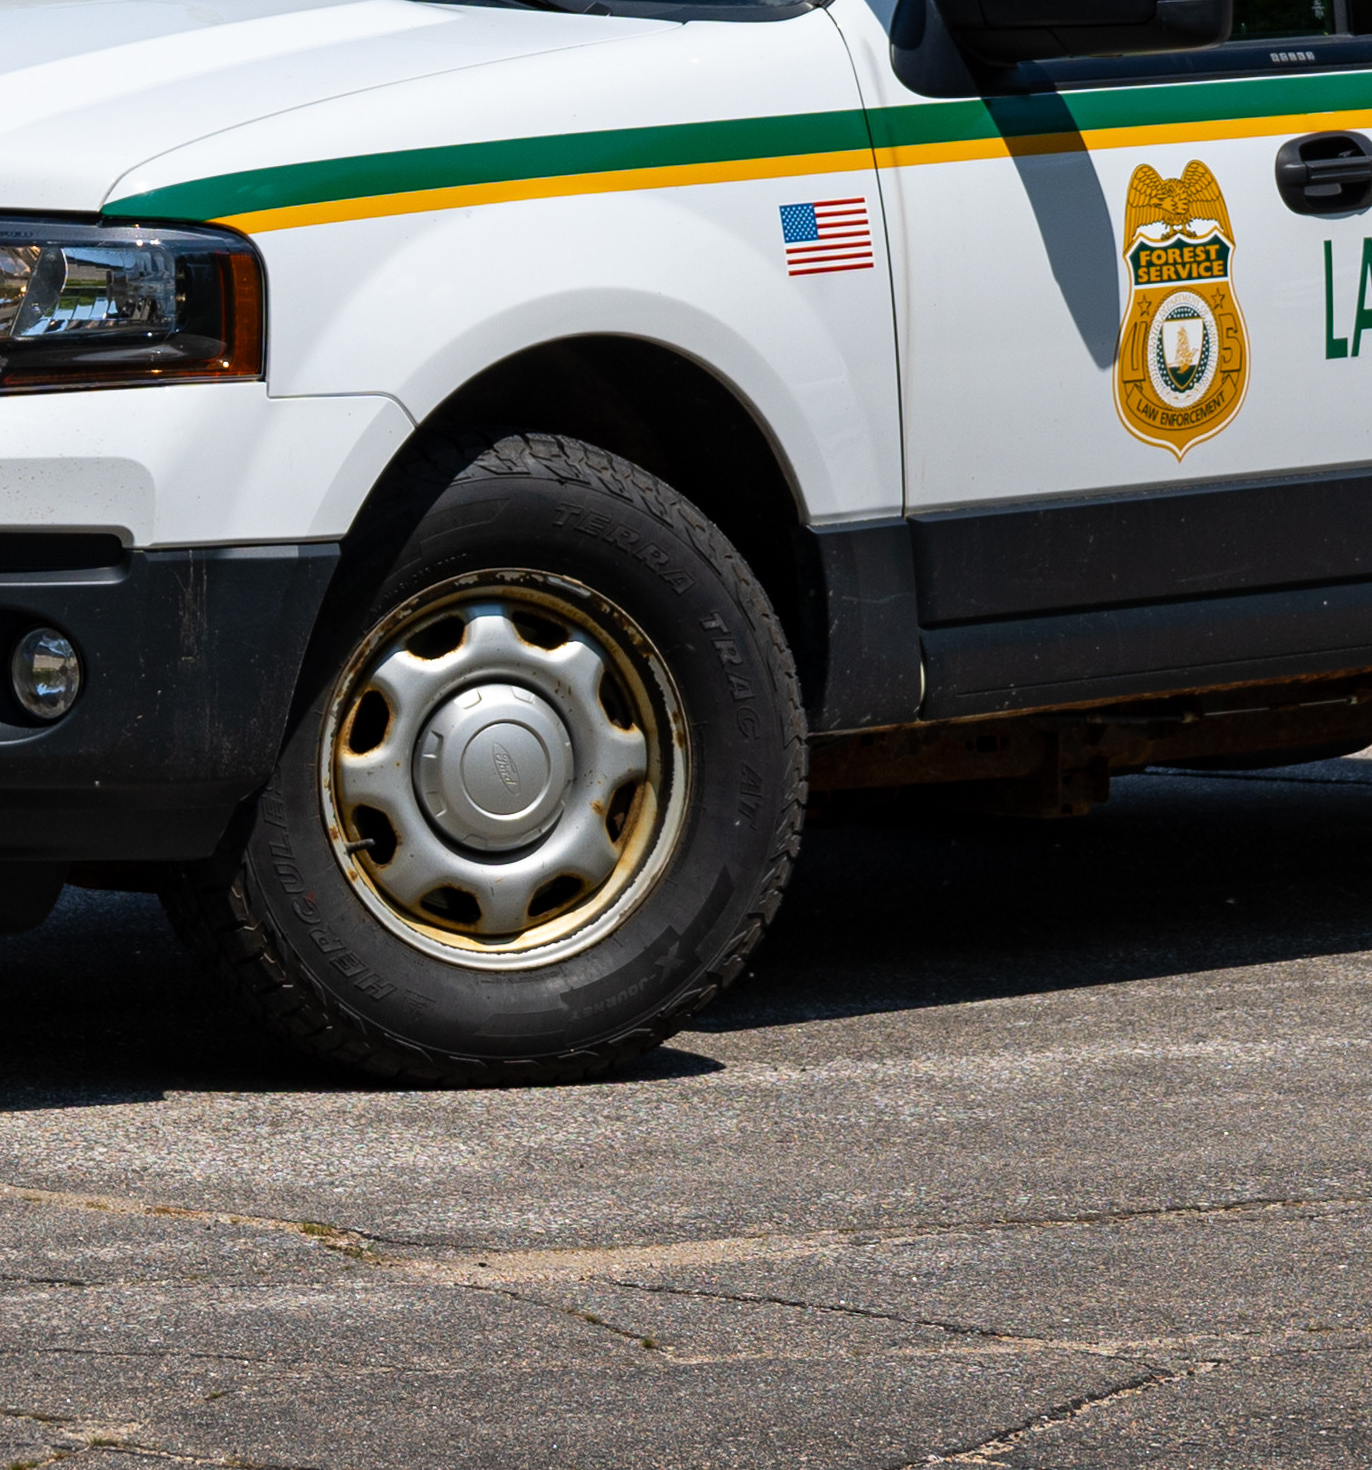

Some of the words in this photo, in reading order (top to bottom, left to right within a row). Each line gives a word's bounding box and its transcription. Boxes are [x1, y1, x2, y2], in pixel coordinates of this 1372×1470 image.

[1139, 244, 1220, 267] FOREST
[1137, 261, 1225, 284] SERVICE
[1135, 397, 1160, 422] LAW
[1160, 390, 1226, 427] ENFORCEMENT
[552, 502, 697, 596] TERRA
[697, 609, 761, 741] TRAC
